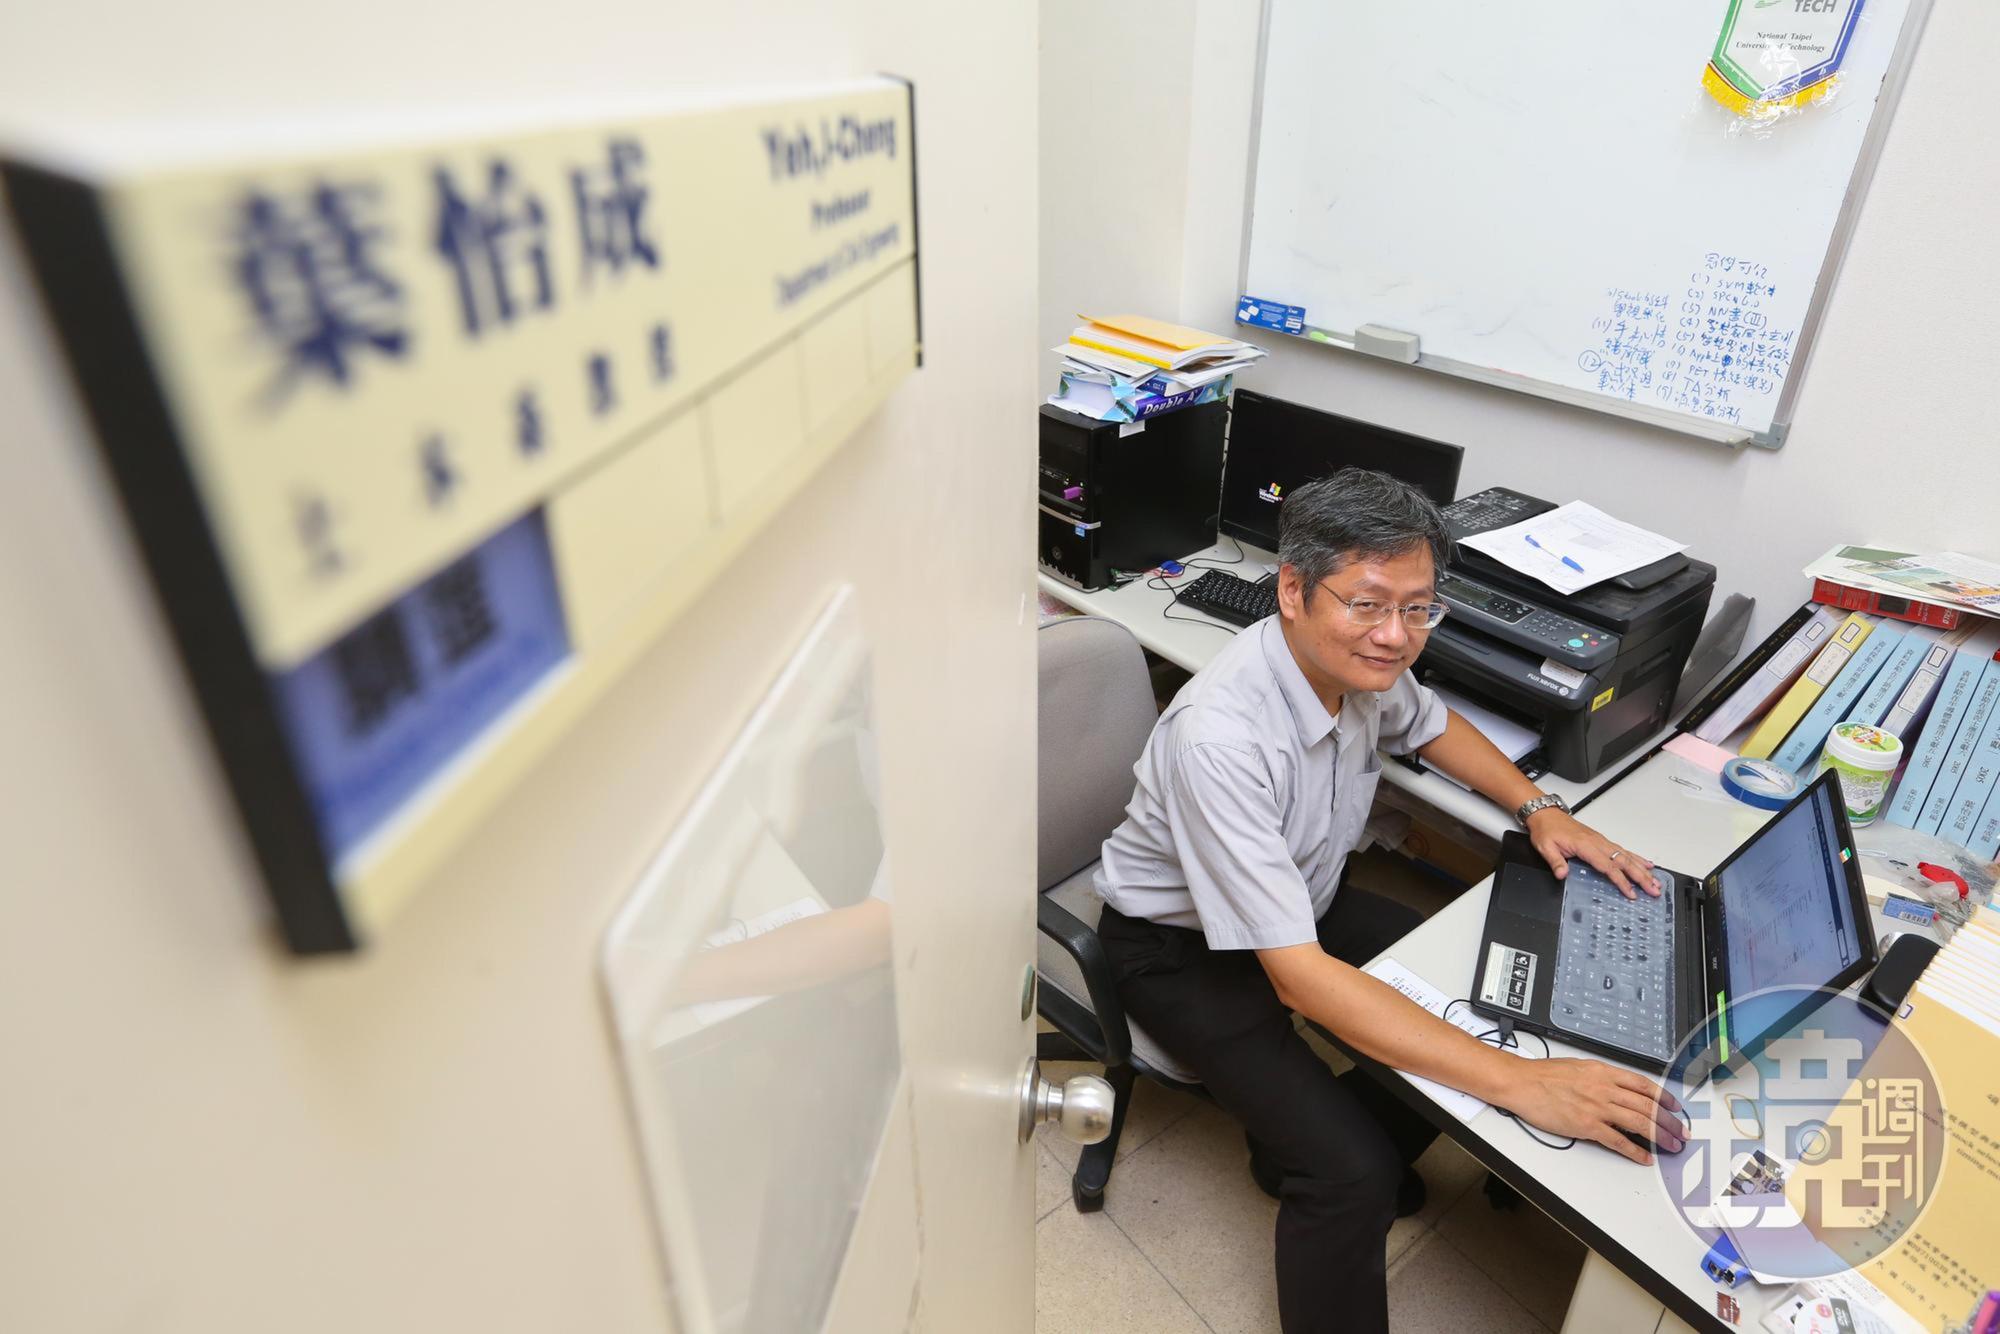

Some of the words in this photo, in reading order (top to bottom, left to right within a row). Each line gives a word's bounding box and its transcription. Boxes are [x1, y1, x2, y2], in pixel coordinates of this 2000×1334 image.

[1793, 0, 1837, 13] TECH
[1757, 31, 1787, 40] National
[1790, 32, 1813, 41] Taipei
[1736, 41, 1773, 49] Universi
[226, 132, 663, 414] 葉怡成
[1143, 395, 1184, 415] Double
[1185, 390, 1195, 403] A
